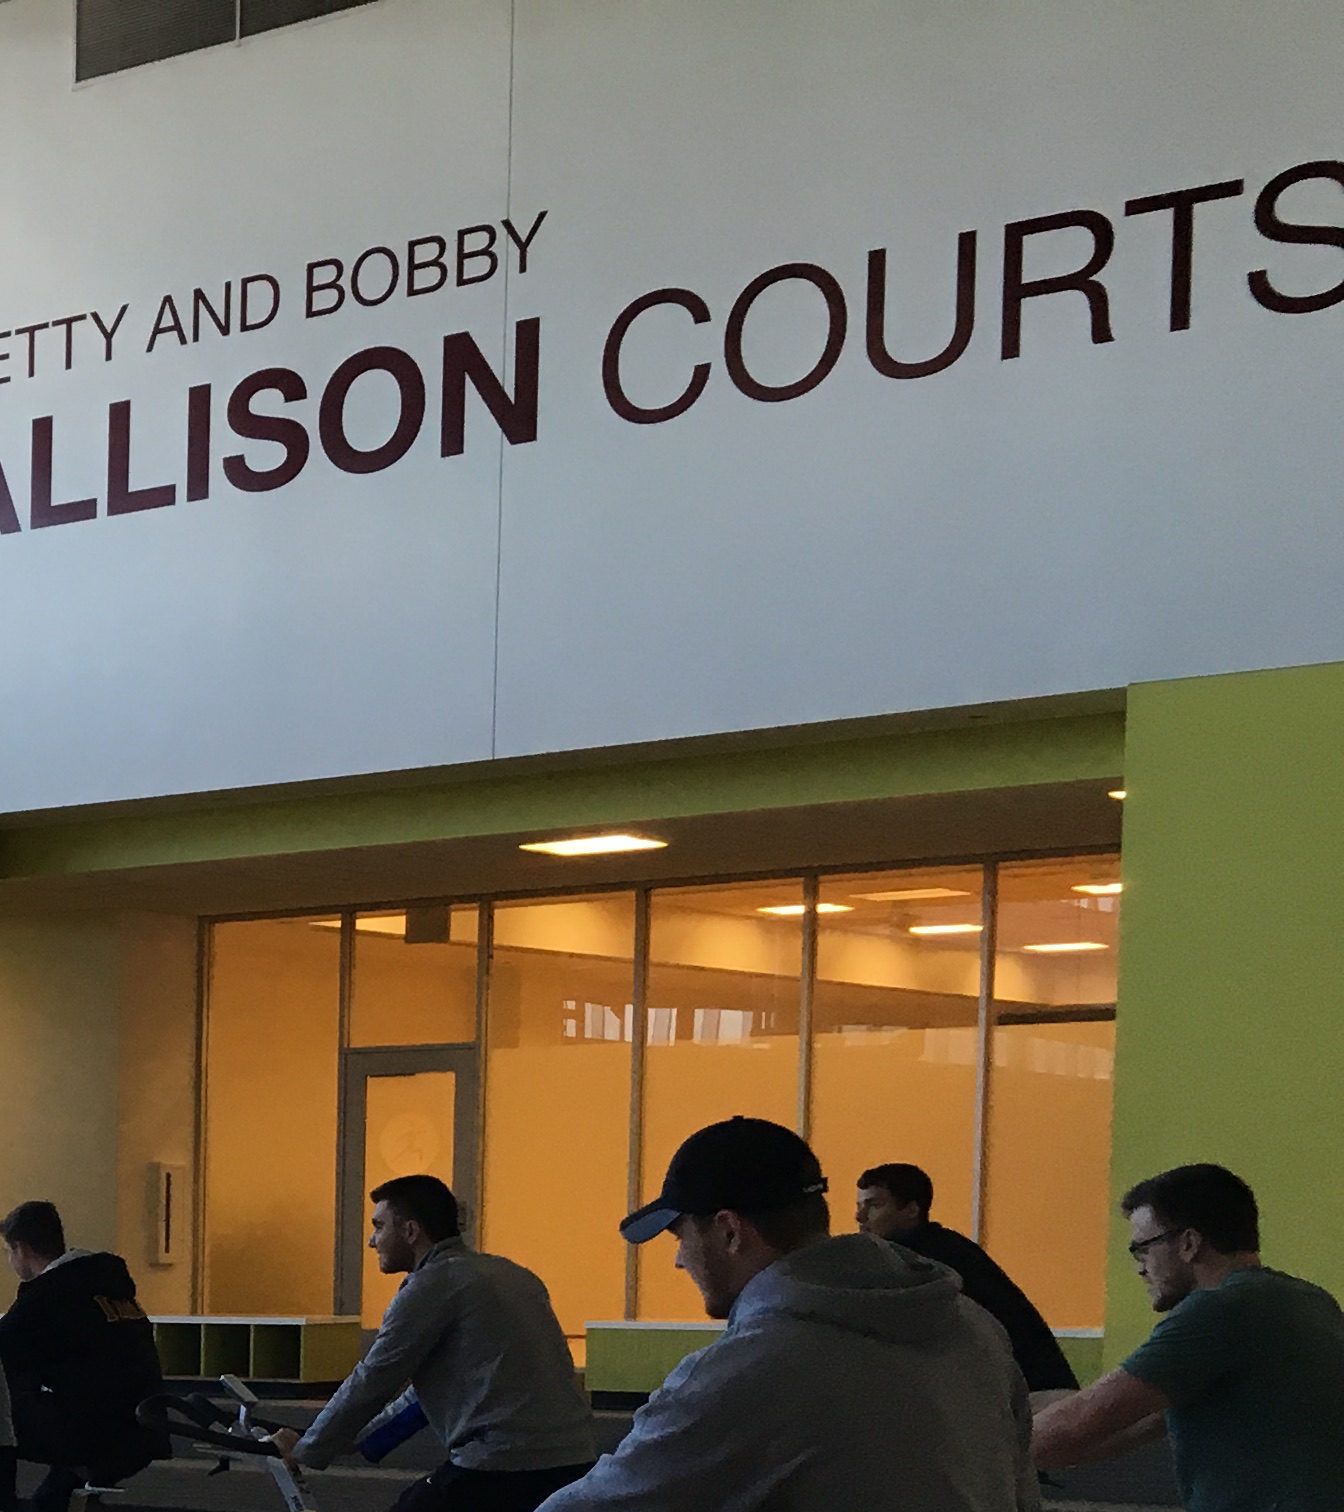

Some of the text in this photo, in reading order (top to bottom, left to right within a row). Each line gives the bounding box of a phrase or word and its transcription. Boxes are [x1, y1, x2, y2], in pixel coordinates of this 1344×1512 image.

[145, 273, 280, 353] AND
[305, 210, 548, 319] BOBBY
[602, 160, 1344, 425] COURTS
